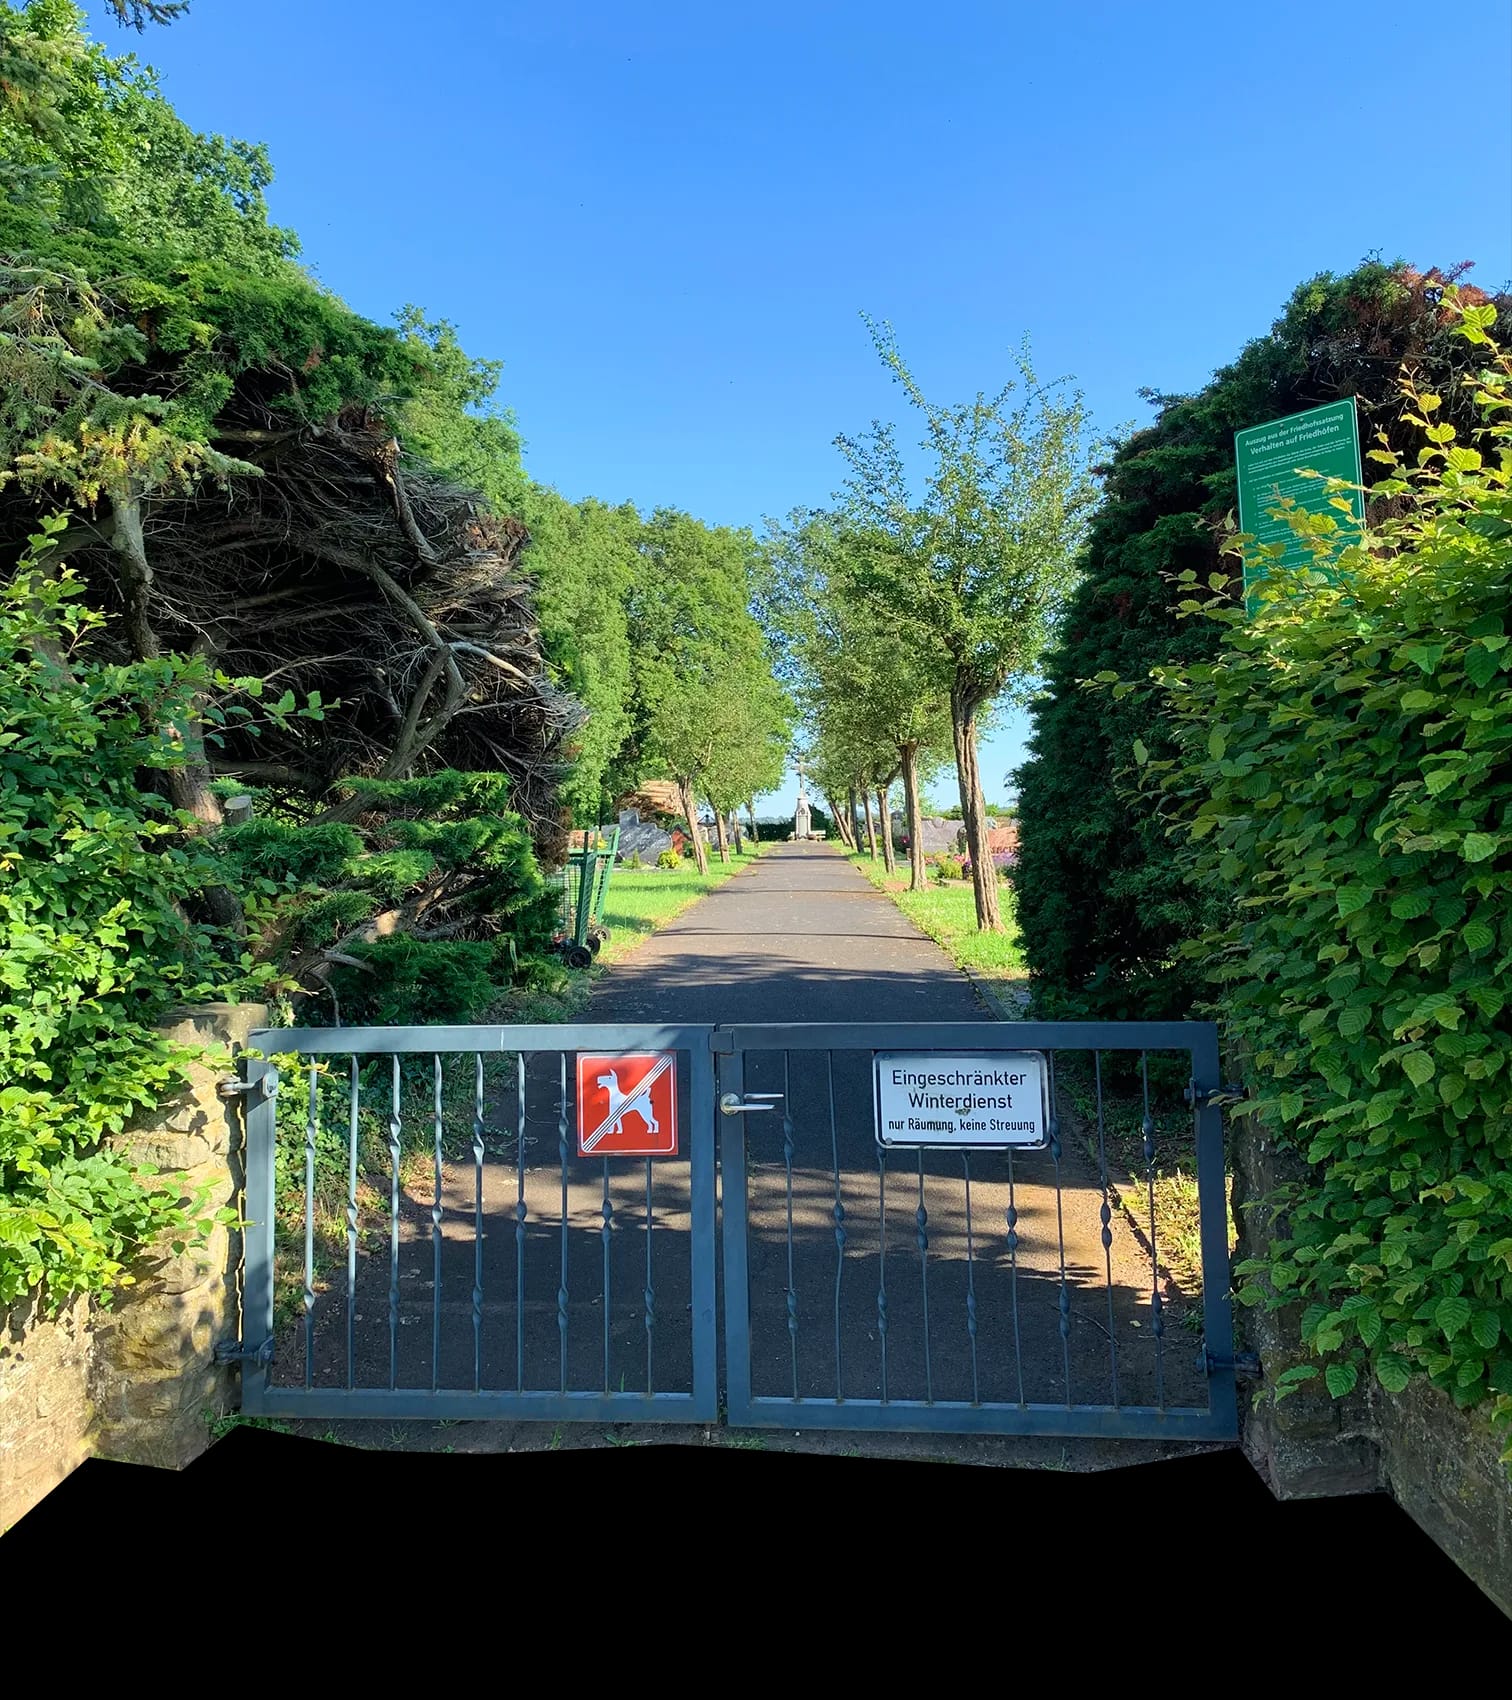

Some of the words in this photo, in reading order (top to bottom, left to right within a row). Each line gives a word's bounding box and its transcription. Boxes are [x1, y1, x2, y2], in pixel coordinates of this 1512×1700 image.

[1245, 436, 1266, 447] Auszug
[1267, 432, 1278, 440] aus
[1279, 428, 1289, 437] der
[1290, 414, 1344, 434] Friedhofssatzung
[1250, 440, 1284, 455] Verhalten
[1285, 434, 1298, 445] auf
[1299, 425, 1340, 441] Friedhöfen
[892, 1069, 1027, 1089] Eingeschränkter
[908, 1092, 1013, 1109] Winterdienst
[888, 1119, 905, 1130] nur
[960, 1118, 987, 1131] keine
[989, 1118, 1036, 1134] Streuung
